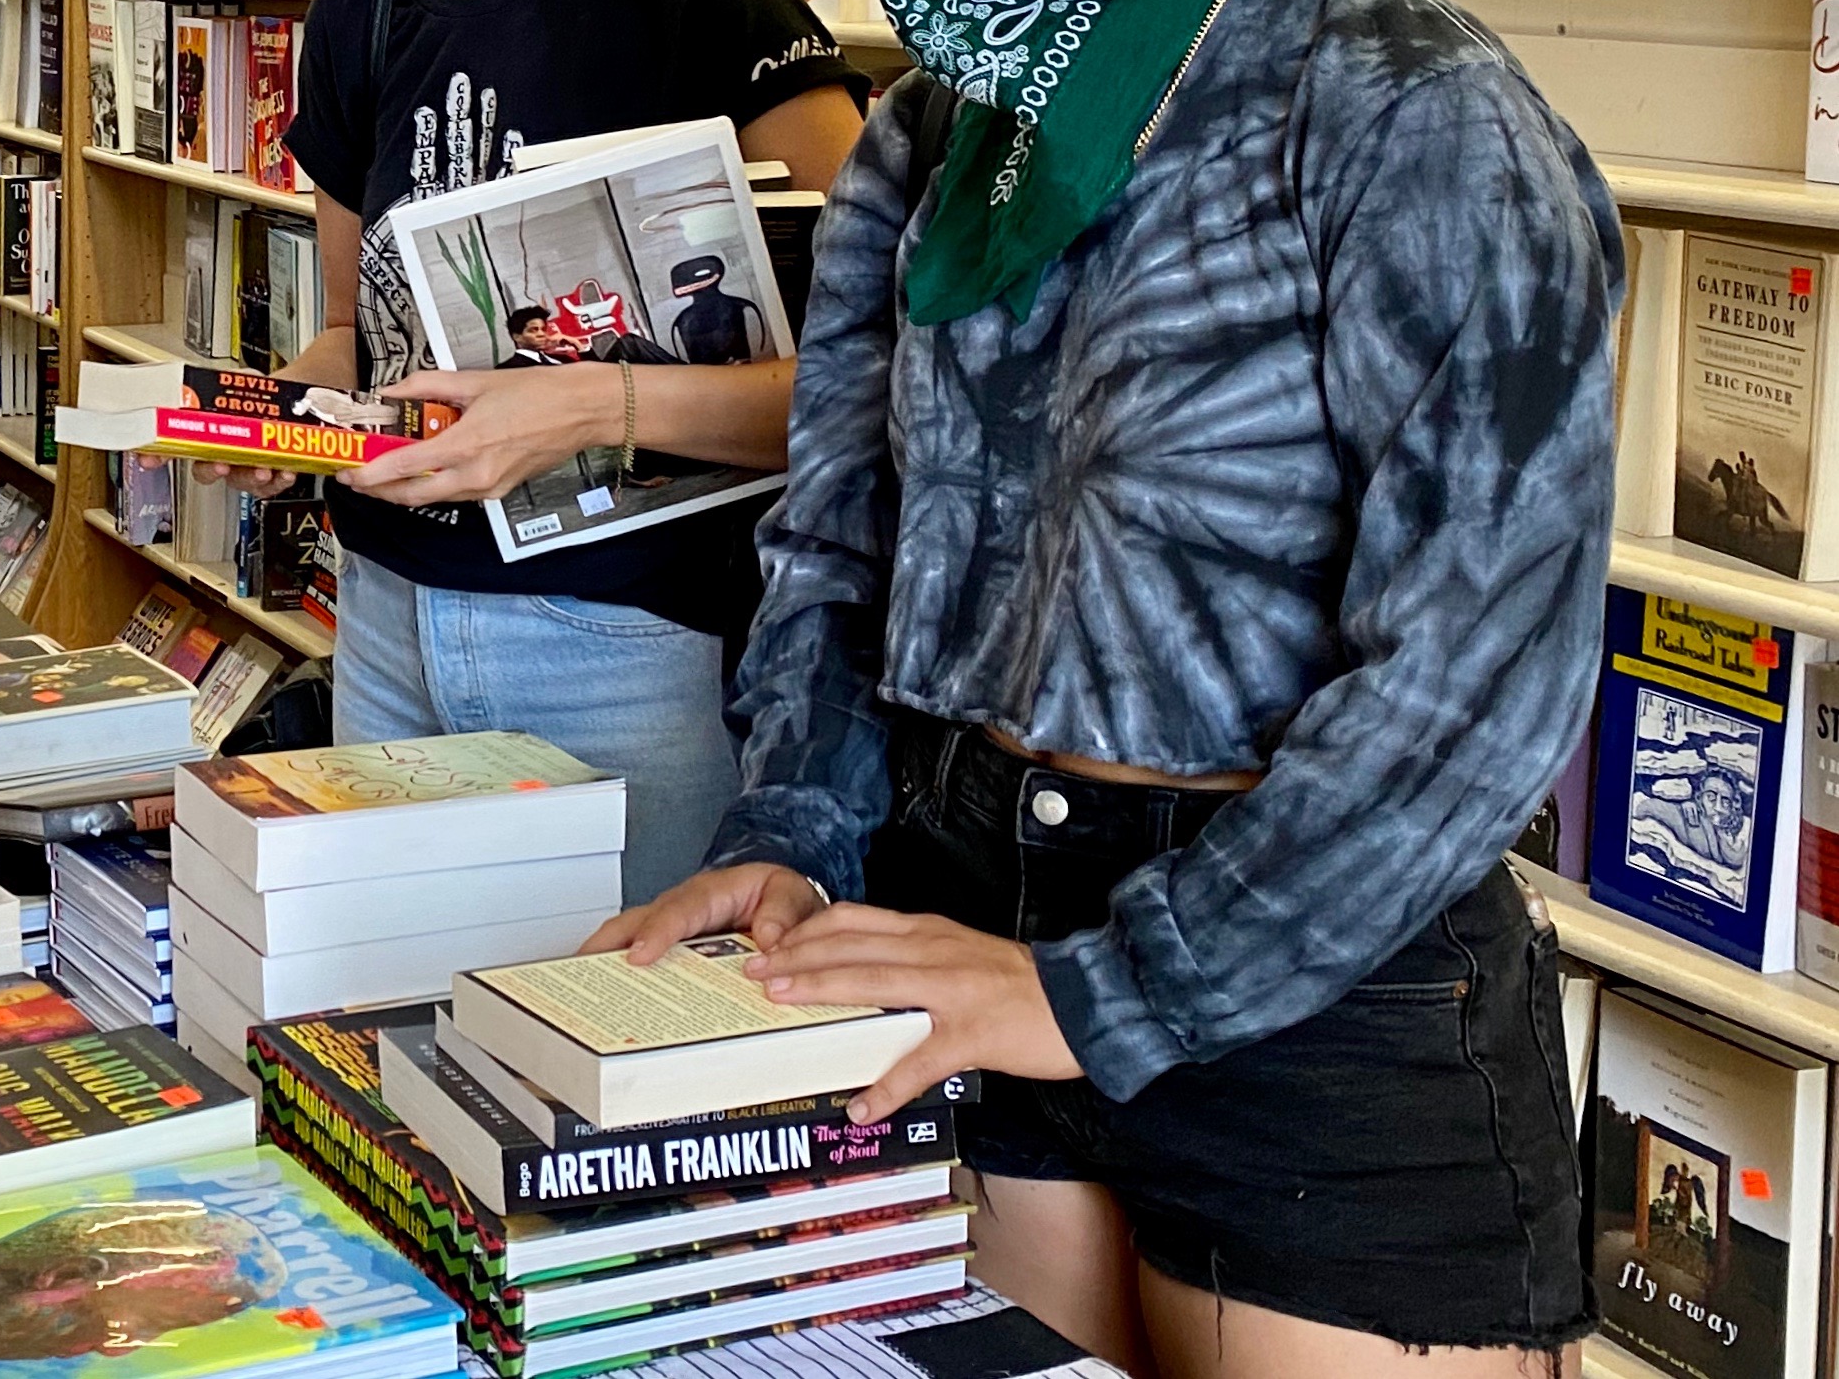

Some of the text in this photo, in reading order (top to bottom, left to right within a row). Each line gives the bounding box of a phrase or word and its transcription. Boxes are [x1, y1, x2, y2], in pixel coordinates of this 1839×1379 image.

[1697, 274, 1810, 313] GATEWAY TO
[1708, 302, 1796, 339] FREEDOM
[219, 373, 280, 393] DEVIL
[1704, 371, 1740, 390] ERIC
[1745, 380, 1793, 406] FONER
[214, 395, 281, 417] GROVE
[167, 417, 367, 459] MONIQUE MORRIS PUSHOUT
[1655, 628, 1756, 678] Railroad Tales
[726, 1098, 816, 1121] BLACK LIBERATION
[812, 1120, 892, 1145] The Queen
[538, 1143, 656, 1200] ARETHA
[664, 1123, 812, 1184] FRANKLIN
[829, 1139, 880, 1165] of Soul
[519, 1162, 531, 1197] Bego
[178, 1159, 434, 1329] Pharrell
[1618, 1261, 1740, 1347] fly away
